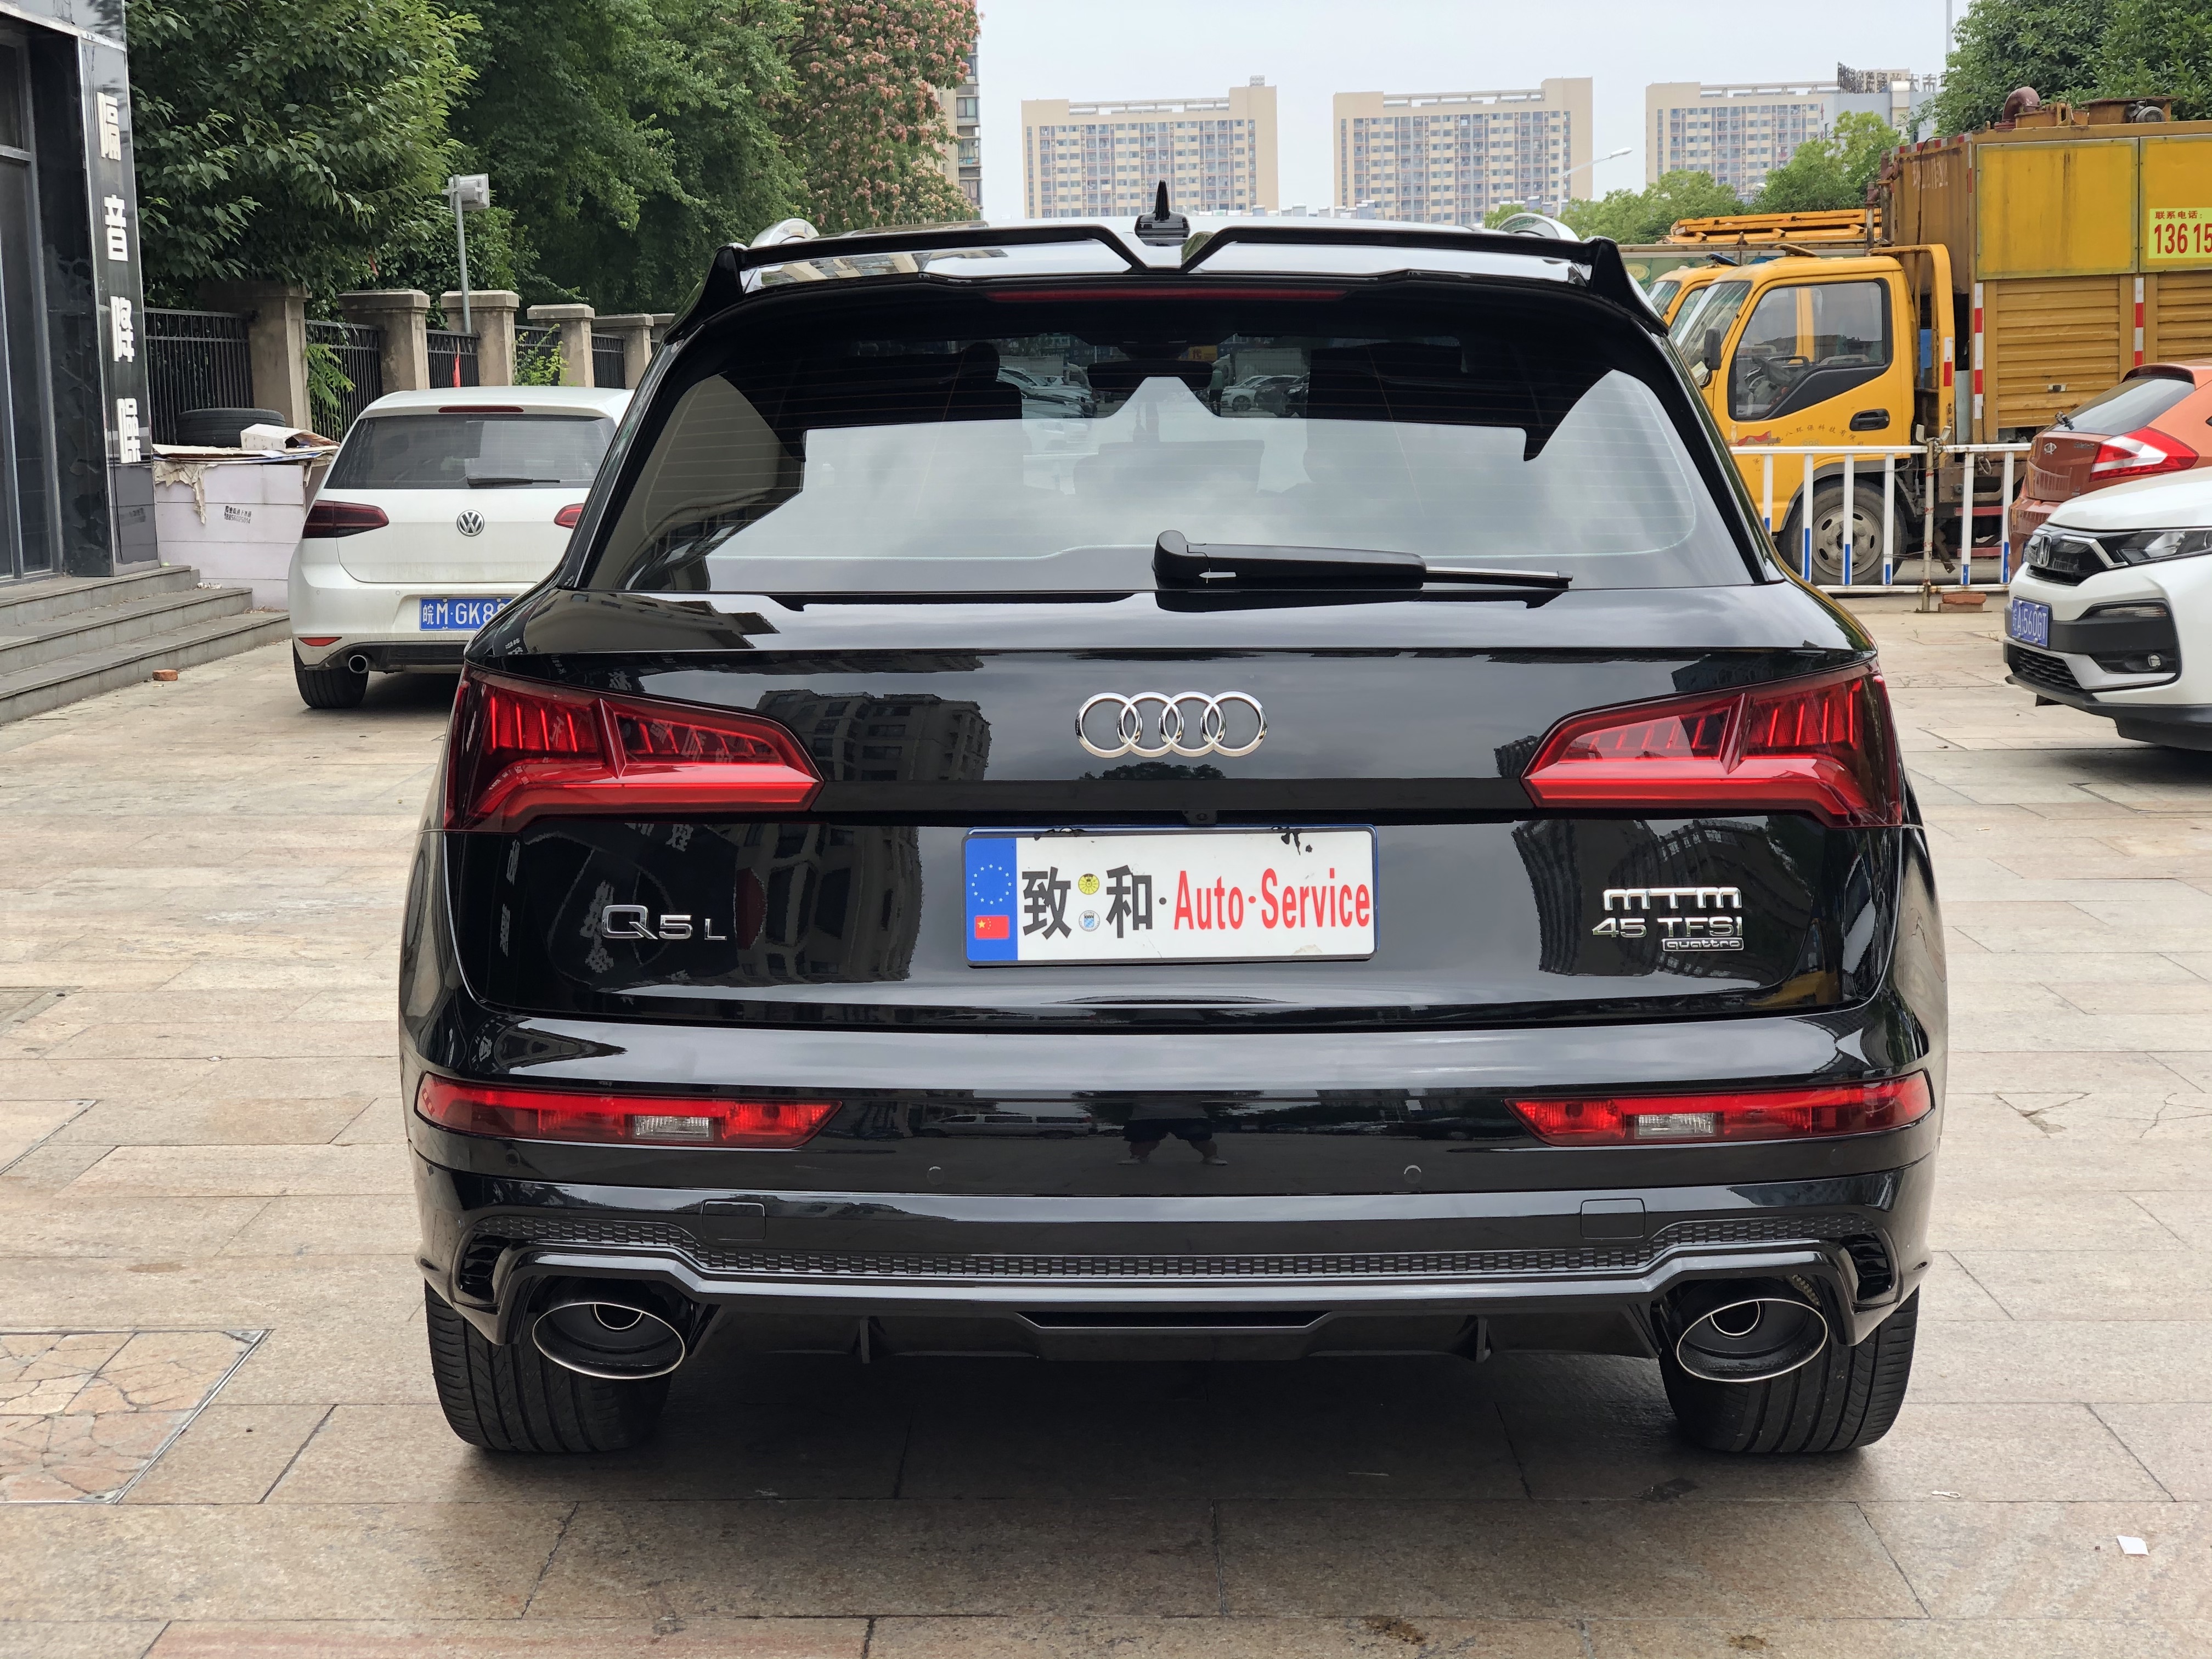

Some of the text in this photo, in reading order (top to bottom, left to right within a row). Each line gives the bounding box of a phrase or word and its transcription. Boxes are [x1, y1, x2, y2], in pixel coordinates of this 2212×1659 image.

[96, 91, 141, 464] 隔音降噪
[1592, 916, 1743, 938] 45 TFSI
[1666, 939, 1741, 950] quattro
